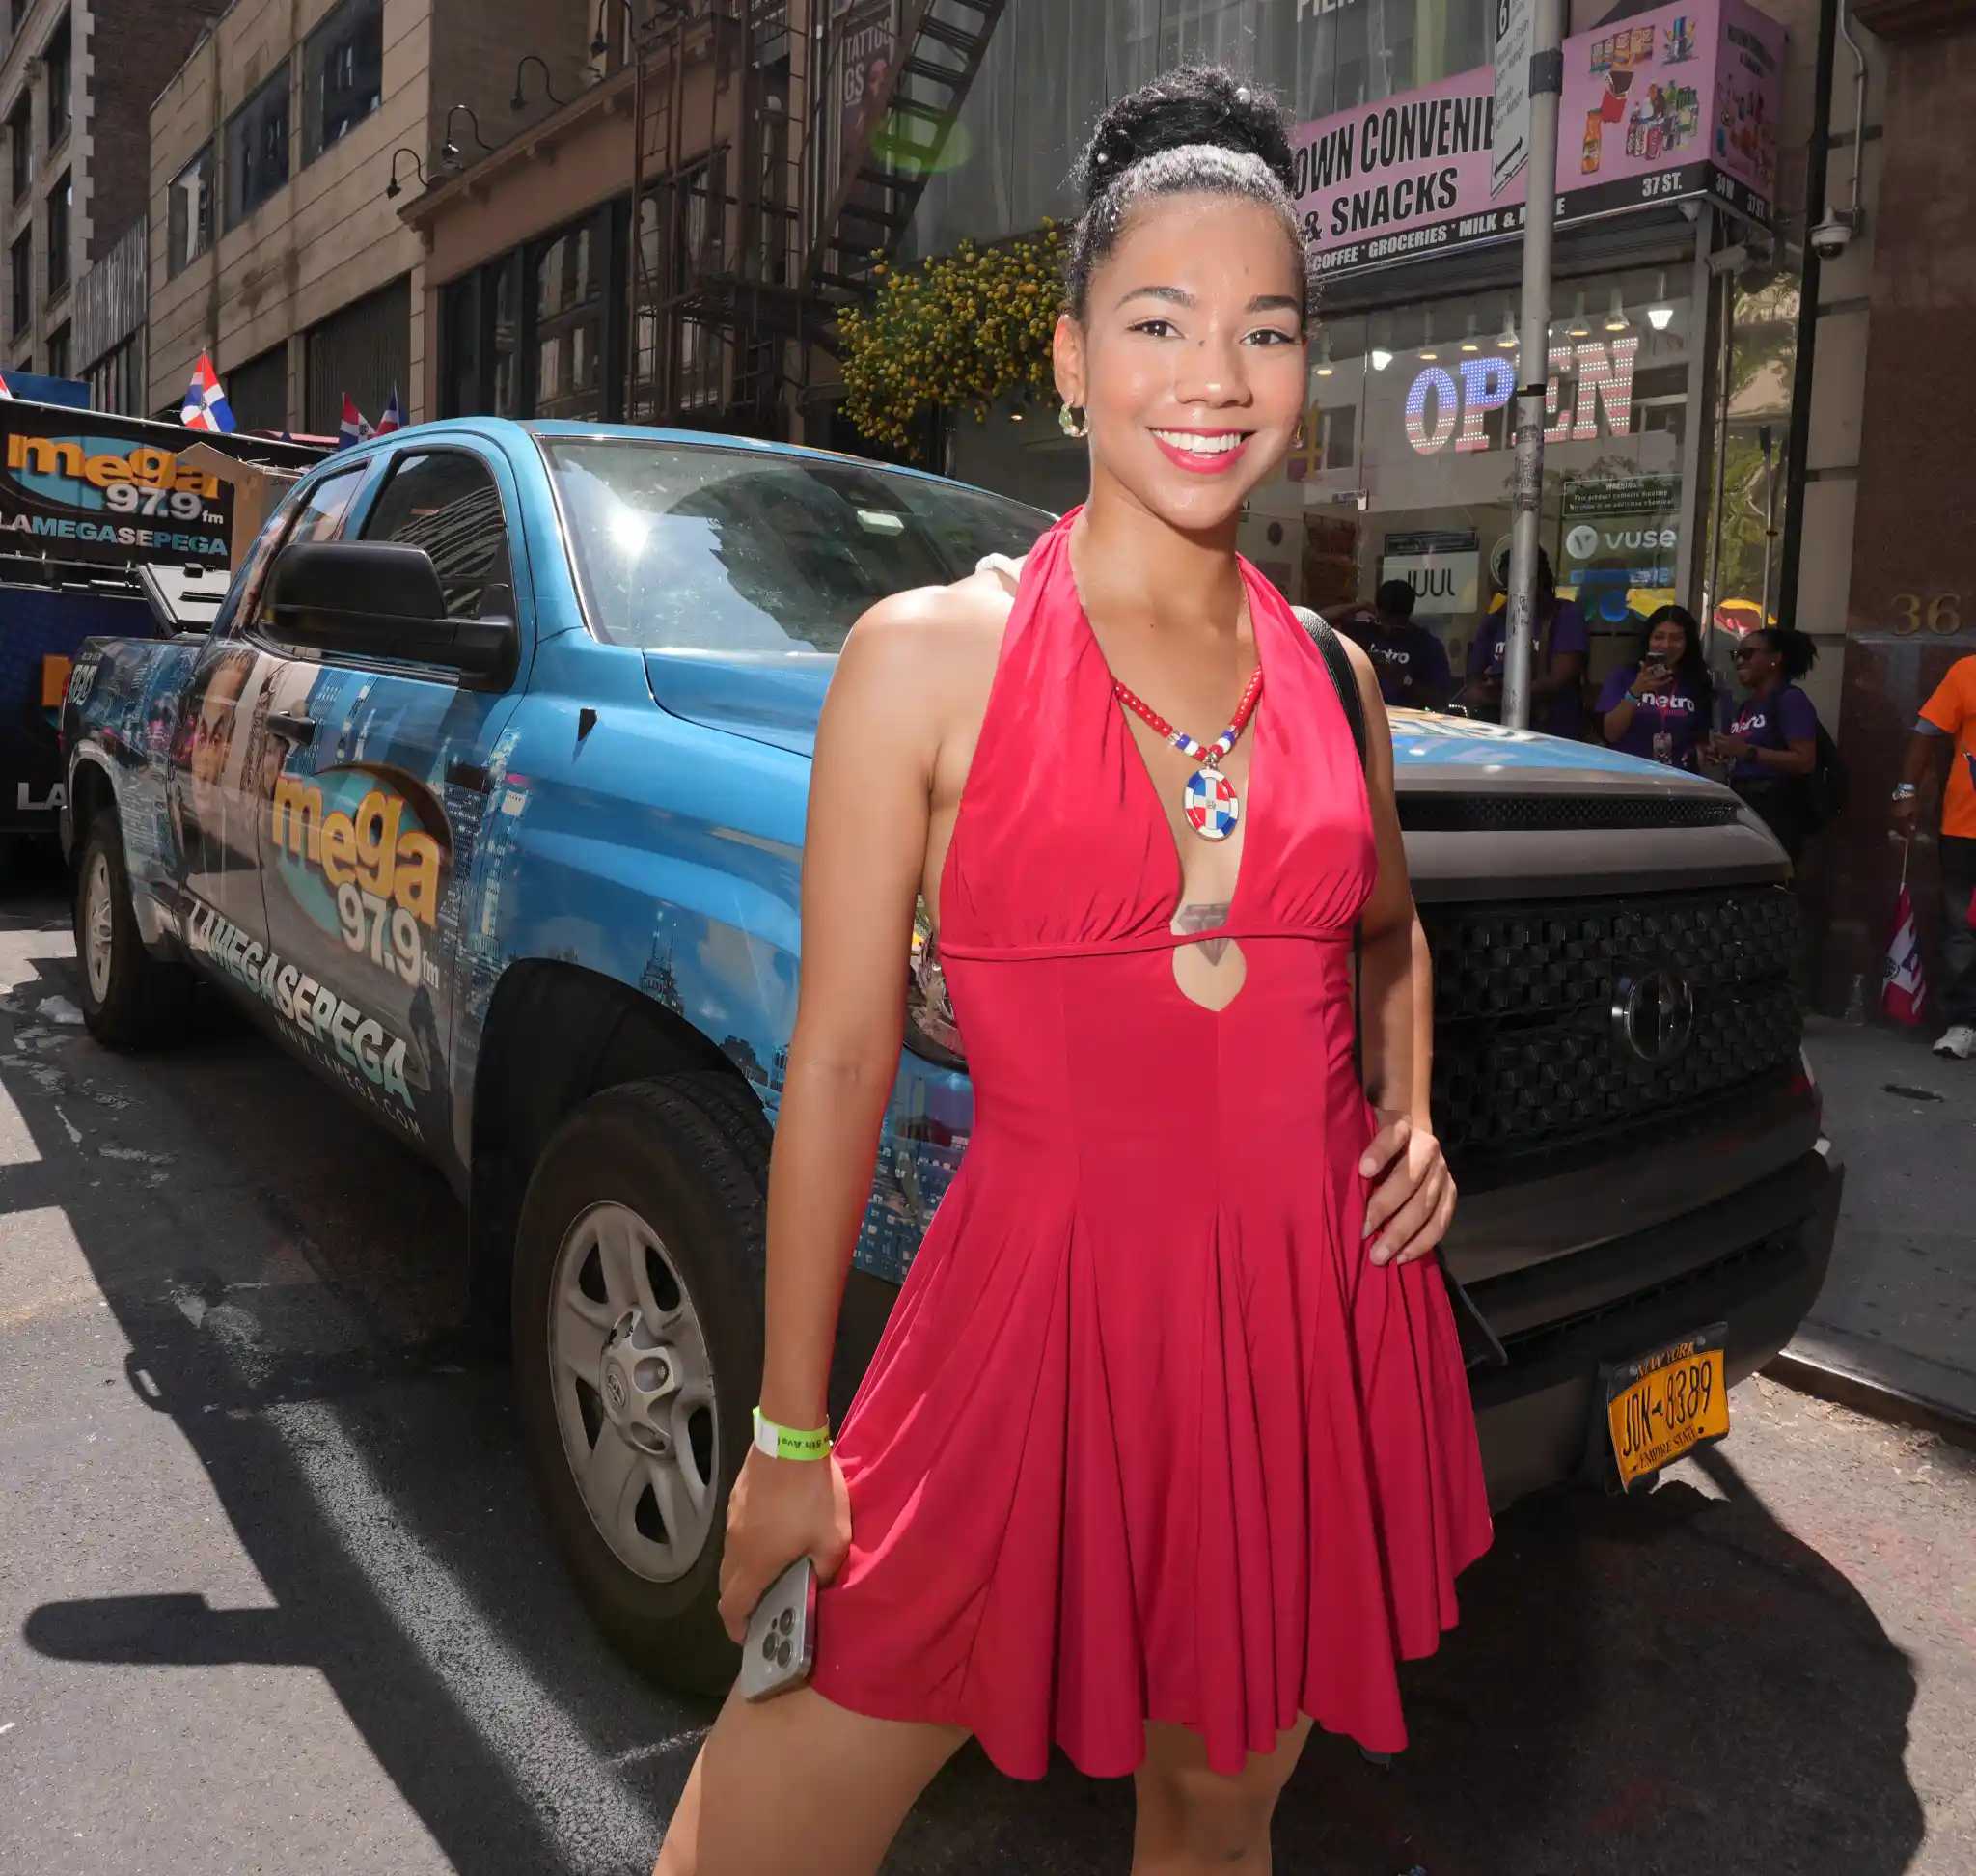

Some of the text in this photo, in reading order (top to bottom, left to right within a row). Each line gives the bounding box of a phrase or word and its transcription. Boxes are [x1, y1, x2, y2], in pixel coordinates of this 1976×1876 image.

[1331, 167, 1458, 236] SNACKS
[1642, 172, 1683, 197] 37 ST.
[1312, 212, 1516, 271] COFFEE GROCERIES MILK &
[8, 433, 220, 499] mega
[106, 483, 224, 525] 97.9 fm
[1605, 529, 1677, 549] vuse
[1892, 593, 1961, 636] 36
[274, 777, 440, 927] mega
[338, 882, 440, 990] 97.9 fm
[188, 900, 416, 1113] LAMEGASEPEGA
